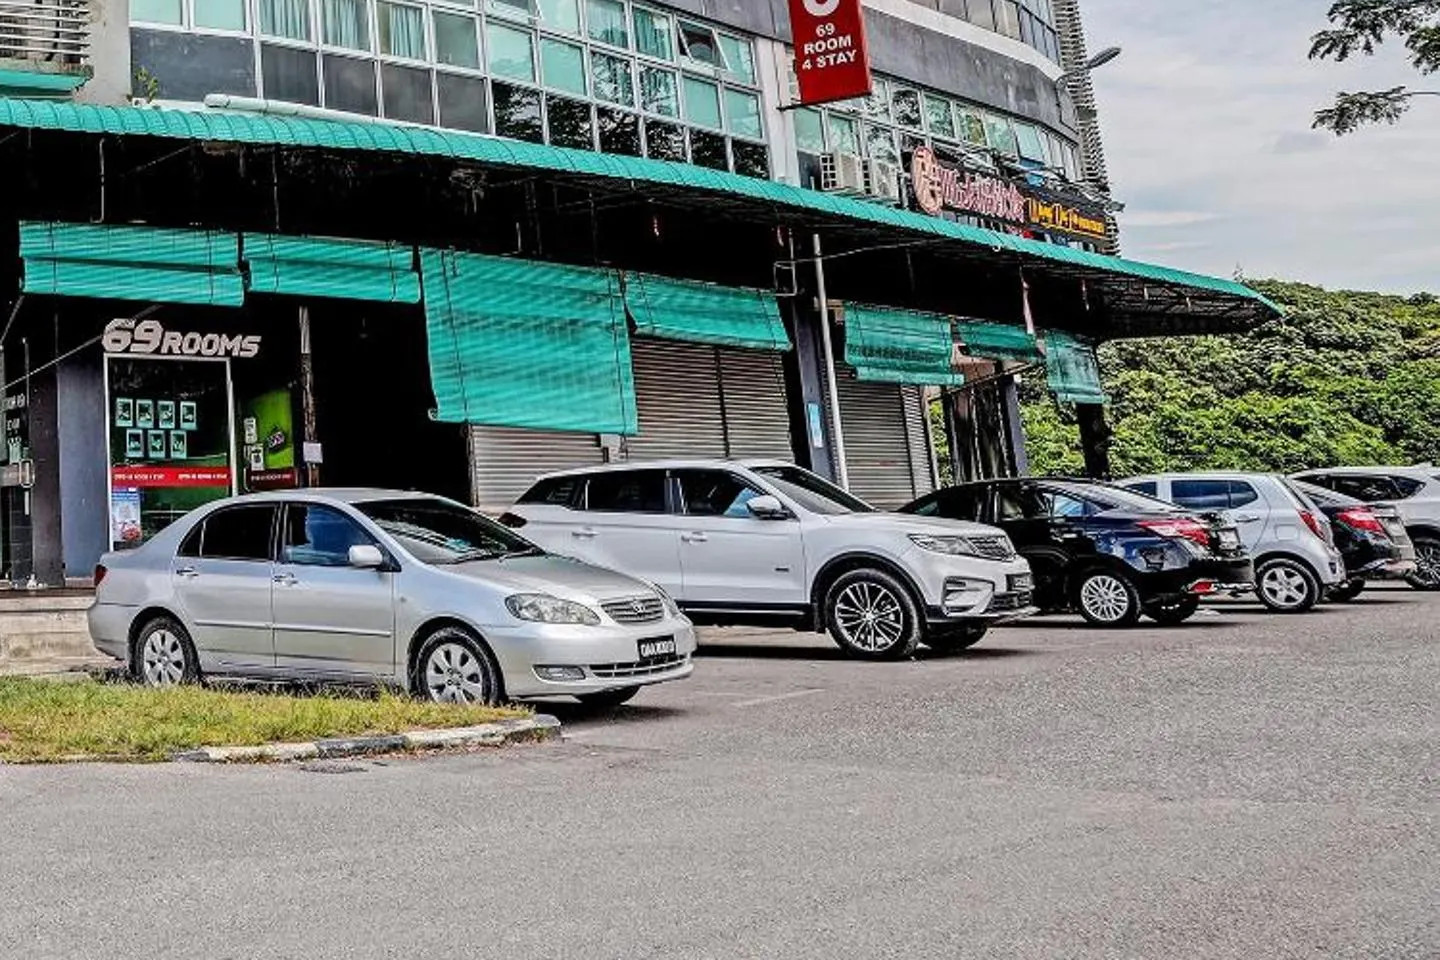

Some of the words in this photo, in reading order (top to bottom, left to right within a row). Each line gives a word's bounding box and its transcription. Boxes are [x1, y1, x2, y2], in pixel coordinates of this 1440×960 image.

[815, 22, 836, 38] 69
[803, 34, 852, 56] ROOM
[801, 58, 813, 71] 4
[816, 49, 857, 69] STAY
